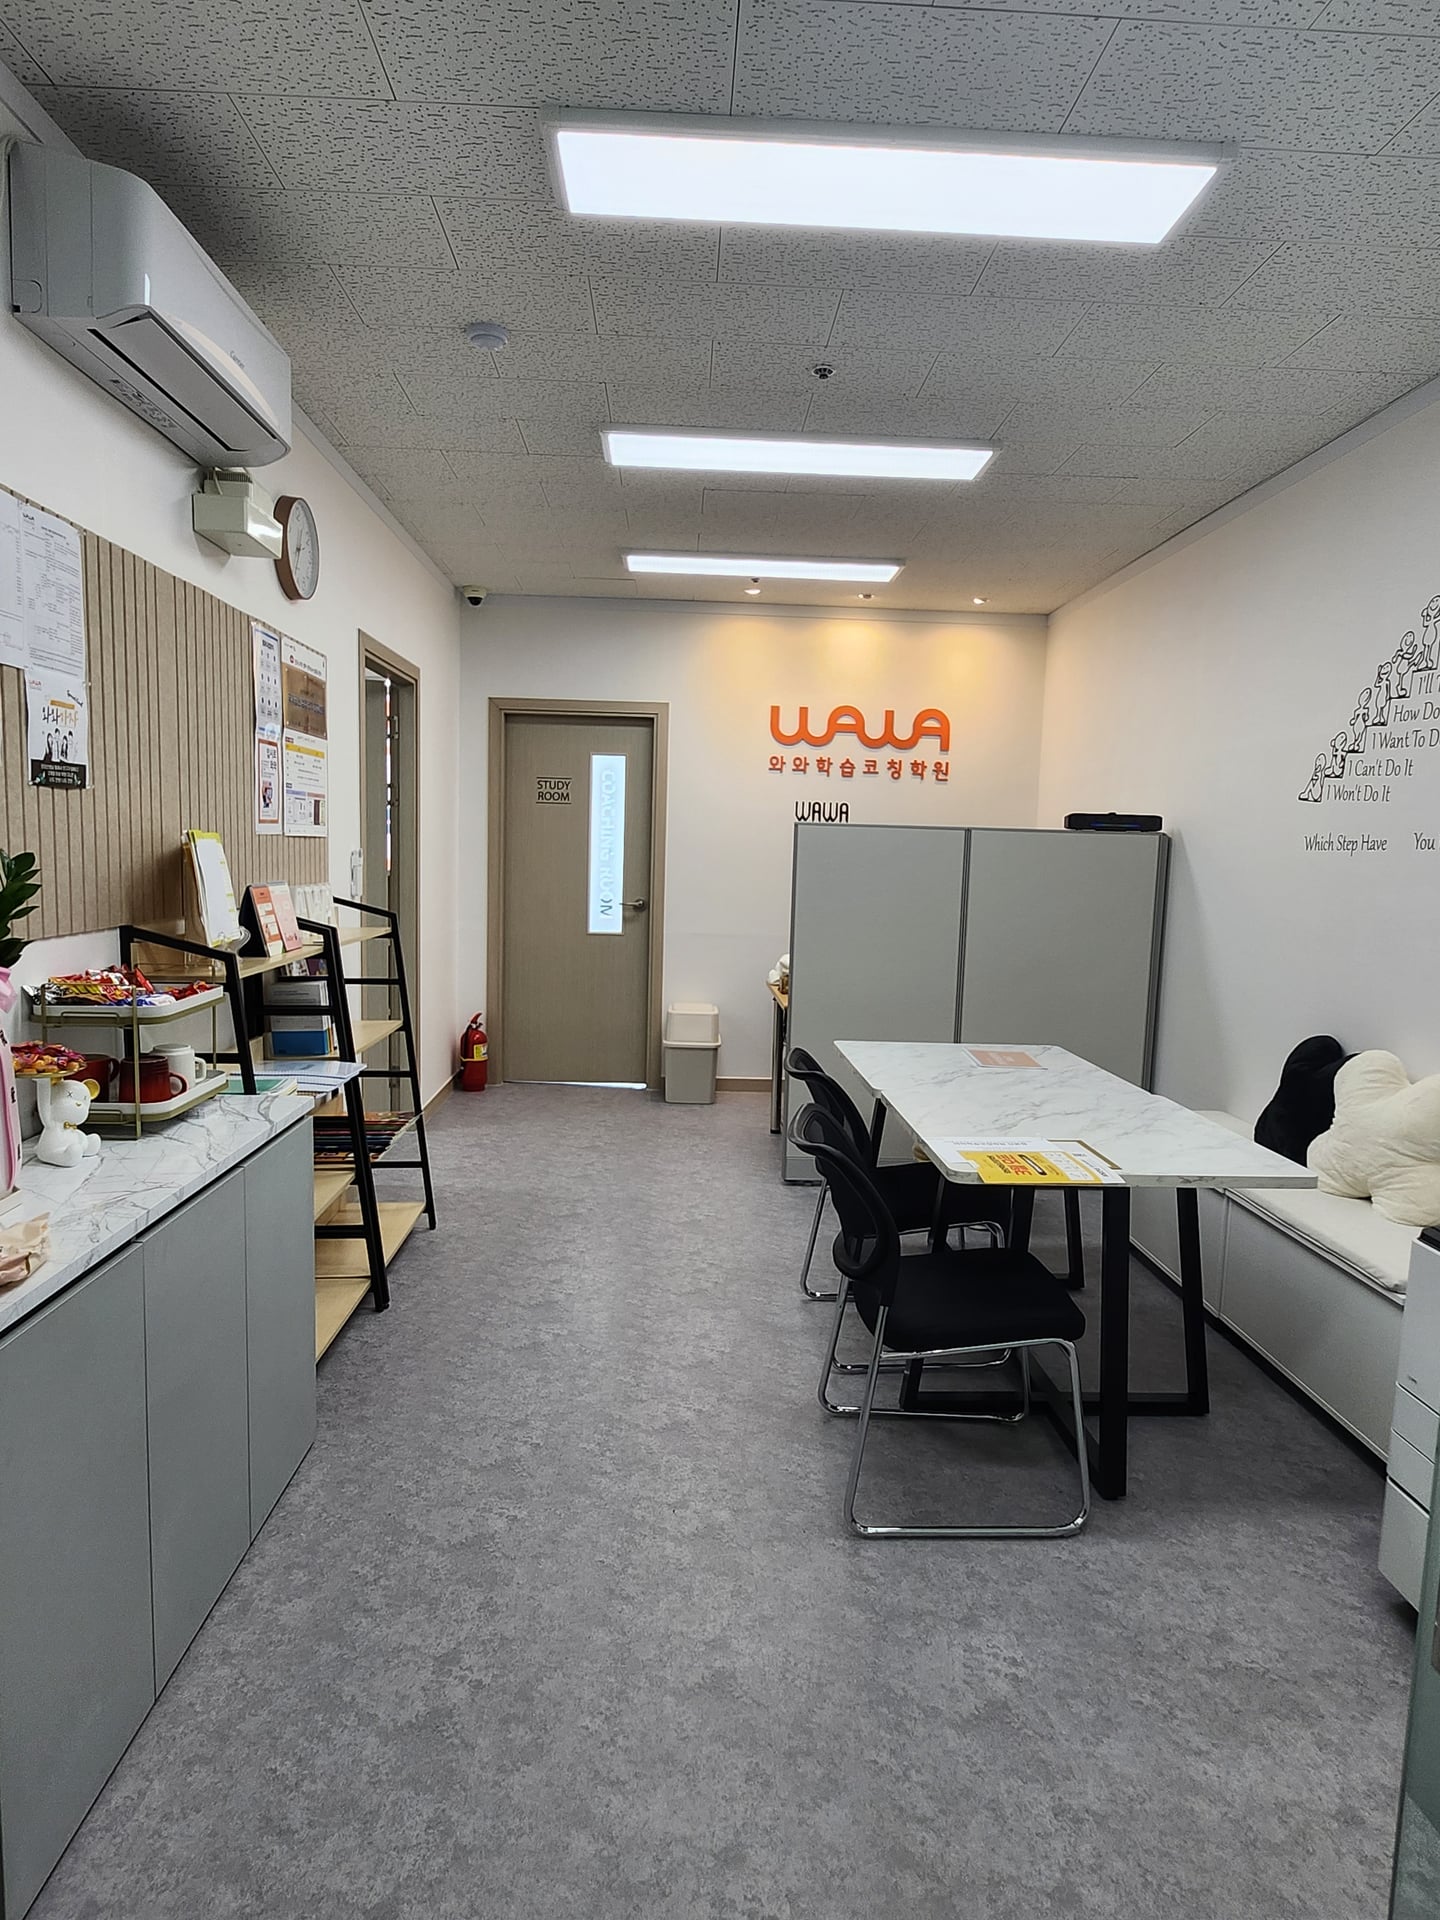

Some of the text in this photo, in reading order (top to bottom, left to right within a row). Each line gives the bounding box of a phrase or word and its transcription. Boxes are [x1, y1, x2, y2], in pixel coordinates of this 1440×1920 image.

[1393, 705, 1420, 722] How
[770, 704, 950, 752] WAWA
[1372, 728, 1440, 750] I Want To D
[768, 755, 949, 782] 와와학습코칭학원
[1348, 758, 1414, 777] I Can't Do It
[537, 780, 571, 790] STUDY
[1326, 784, 1391, 802] I Won't Do It
[538, 792, 570, 802] ROOM
[795, 801, 849, 822] WAWA
[1305, 832, 1436, 856] Which Step Have You
